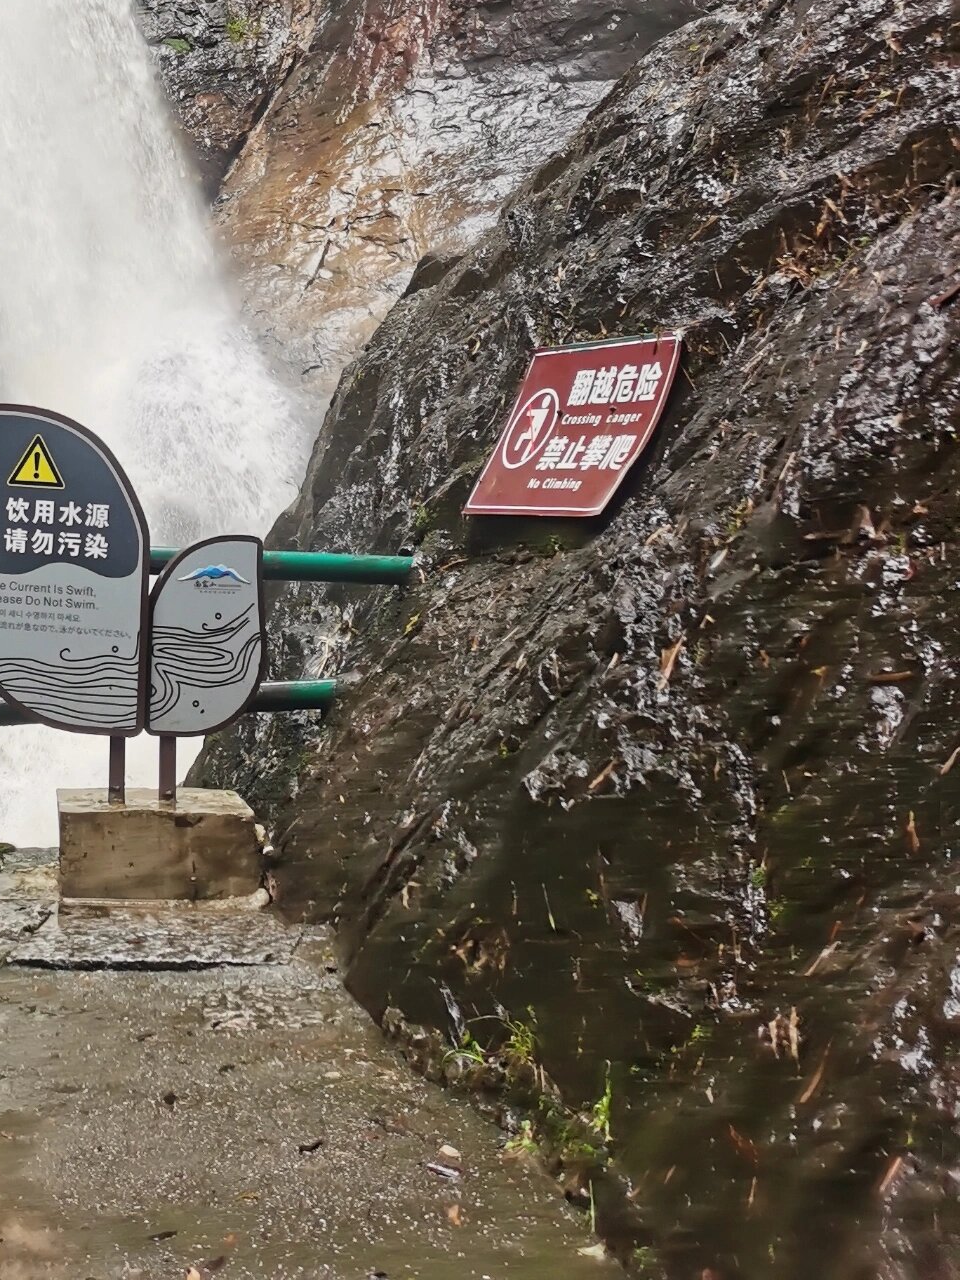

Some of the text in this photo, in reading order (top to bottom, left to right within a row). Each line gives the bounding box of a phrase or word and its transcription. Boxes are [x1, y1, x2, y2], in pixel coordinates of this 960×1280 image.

[567, 361, 663, 407] 翻越危险
[561, 413, 602, 427] Crossing
[536, 434, 638, 471] 禁止攀爬
[527, 476, 583, 492] No Climbing
[5, 497, 111, 529] 饮用水源
[3, 528, 110, 560] 请勿污染
[8, 581, 51, 594] Current
[53, 584, 64, 595] Is
[25, 595, 41, 606] Do
[43, 597, 63, 608] Not
[65, 598, 99, 610] Swim.
